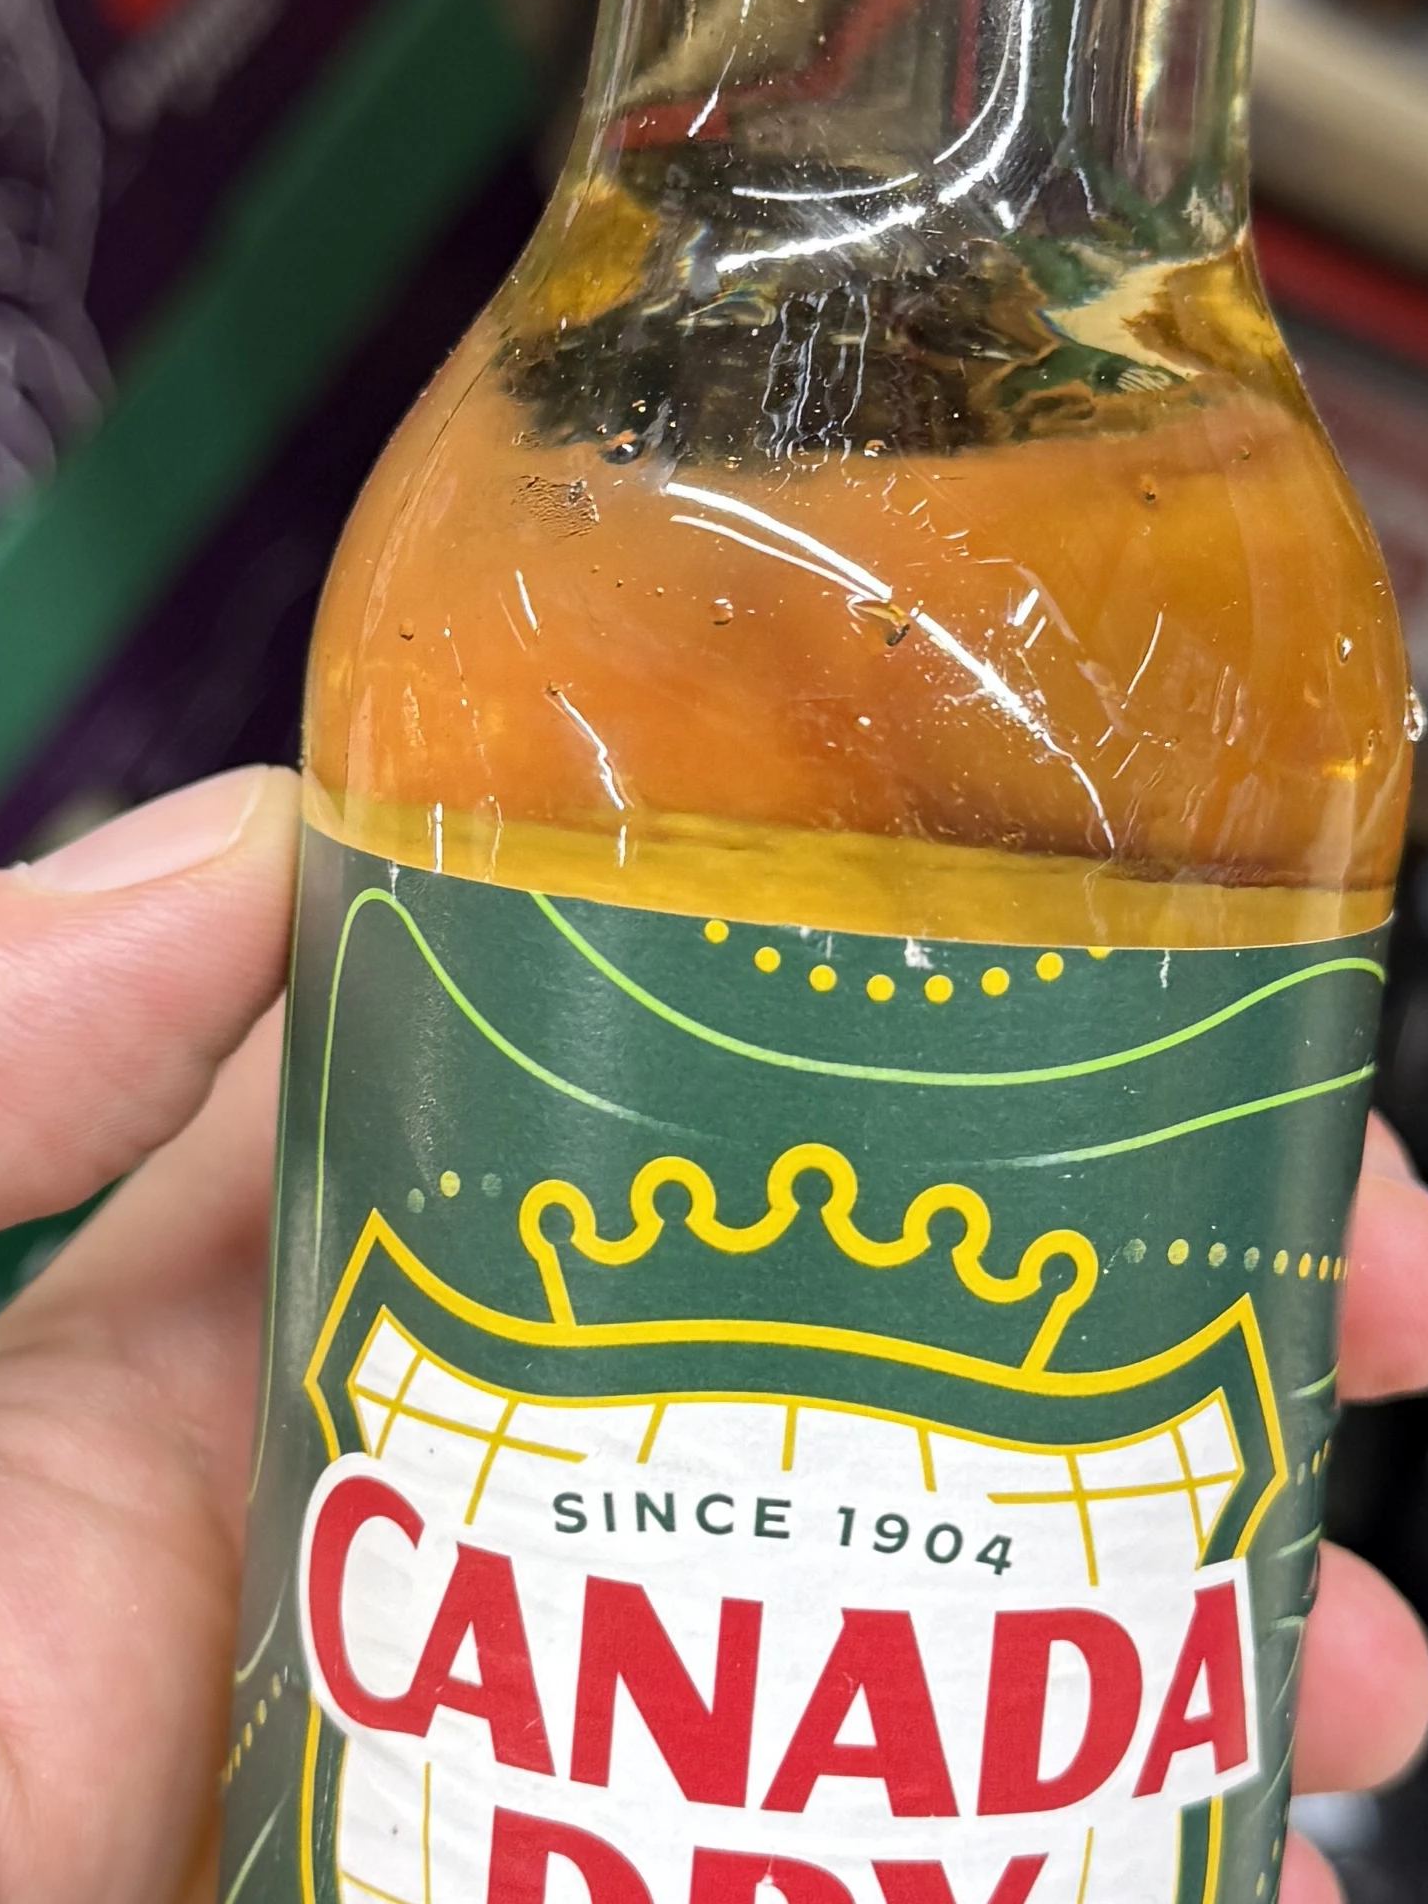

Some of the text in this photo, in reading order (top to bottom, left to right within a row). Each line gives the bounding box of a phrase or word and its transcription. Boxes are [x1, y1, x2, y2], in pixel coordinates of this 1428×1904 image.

[551, 1490, 1015, 1578] SINCE 1904
[307, 1474, 1251, 1819] CANADA
